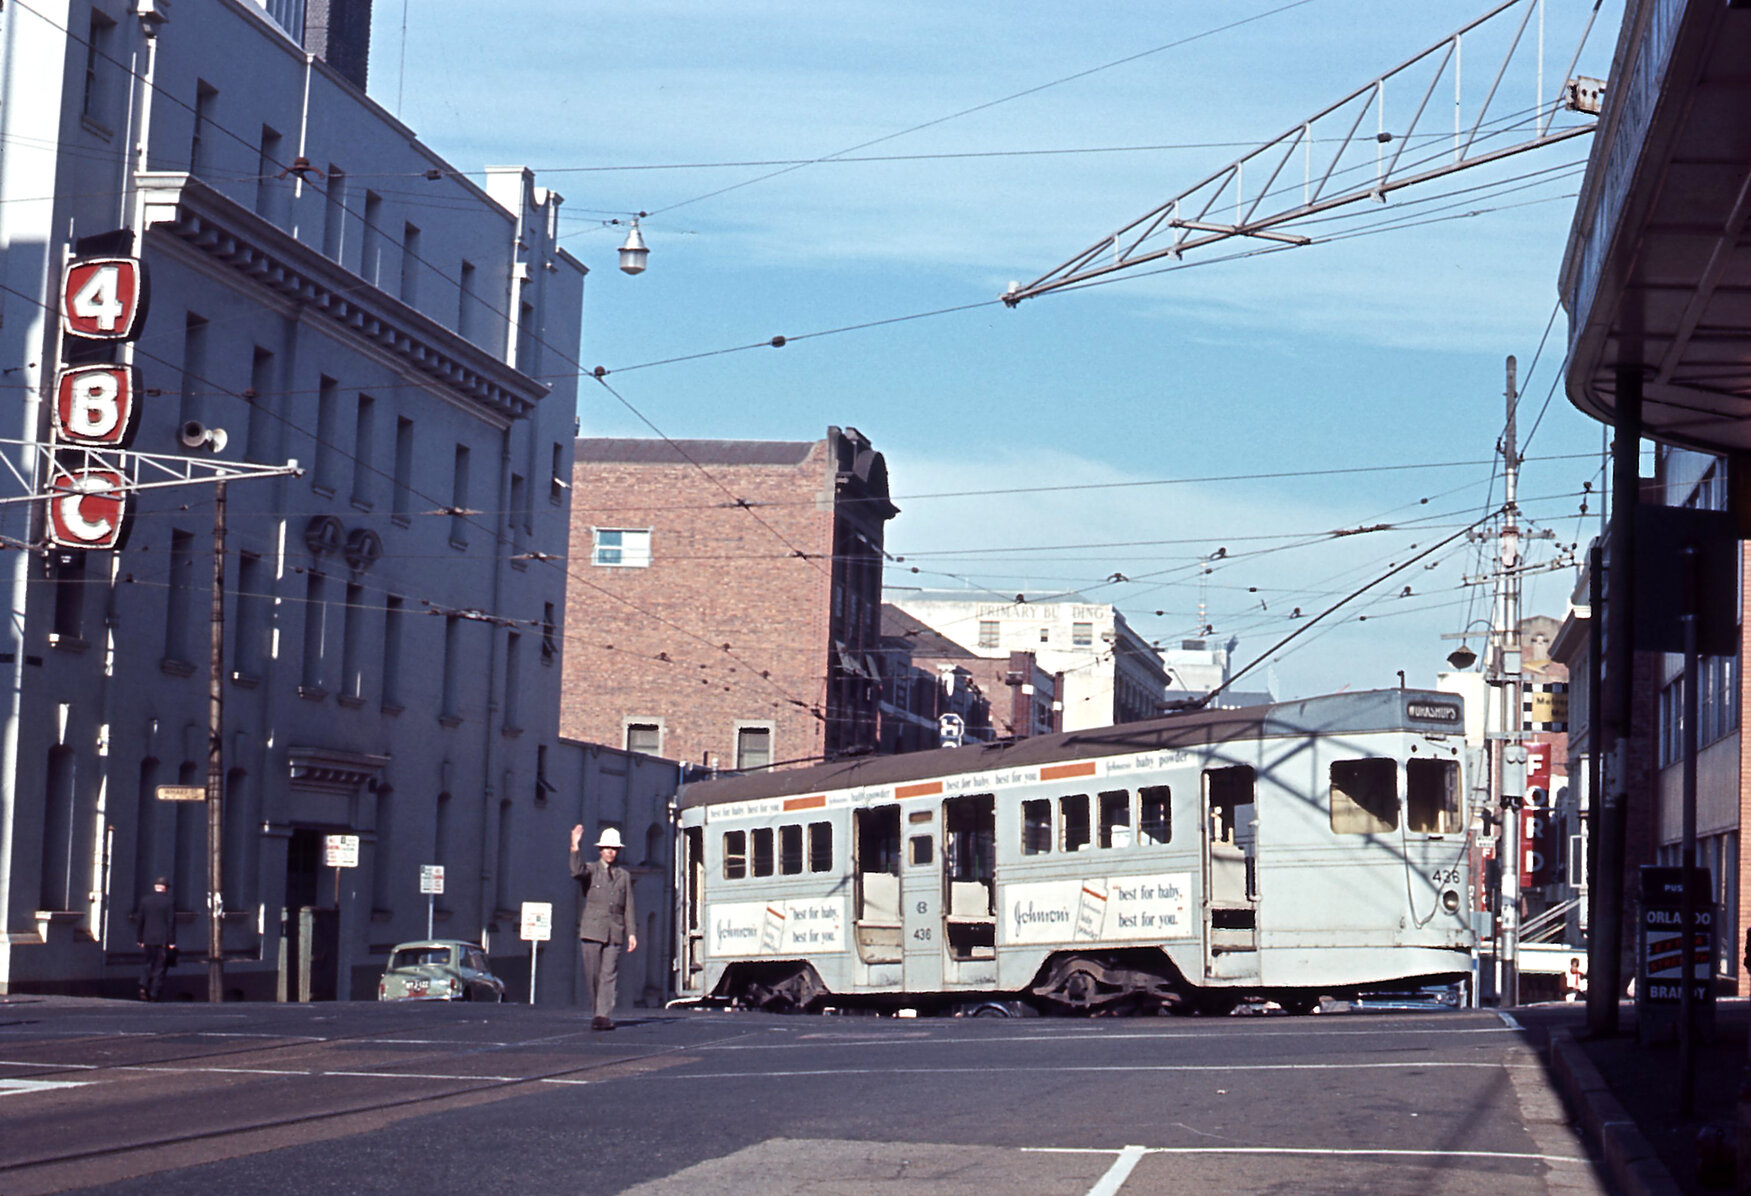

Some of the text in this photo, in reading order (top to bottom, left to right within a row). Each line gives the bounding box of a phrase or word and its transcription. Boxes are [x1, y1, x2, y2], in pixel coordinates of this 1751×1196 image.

[980, 603, 1104, 620] PRIMARY BUDING
[1136, 755, 1154, 769] baby
[1159, 751, 1189, 768] powder
[1012, 771, 1022, 783] for
[1524, 754, 1547, 873] FORD
[1432, 869, 1460, 884] 436
[1141, 884, 1155, 899] for
[1664, 884, 1683, 892] PUS
[809, 906, 819, 919] for
[1119, 913, 1137, 927] best
[1141, 911, 1155, 926] for
[793, 931, 806, 943] best
[809, 929, 819, 943] for
[913, 928, 932, 941] 436
